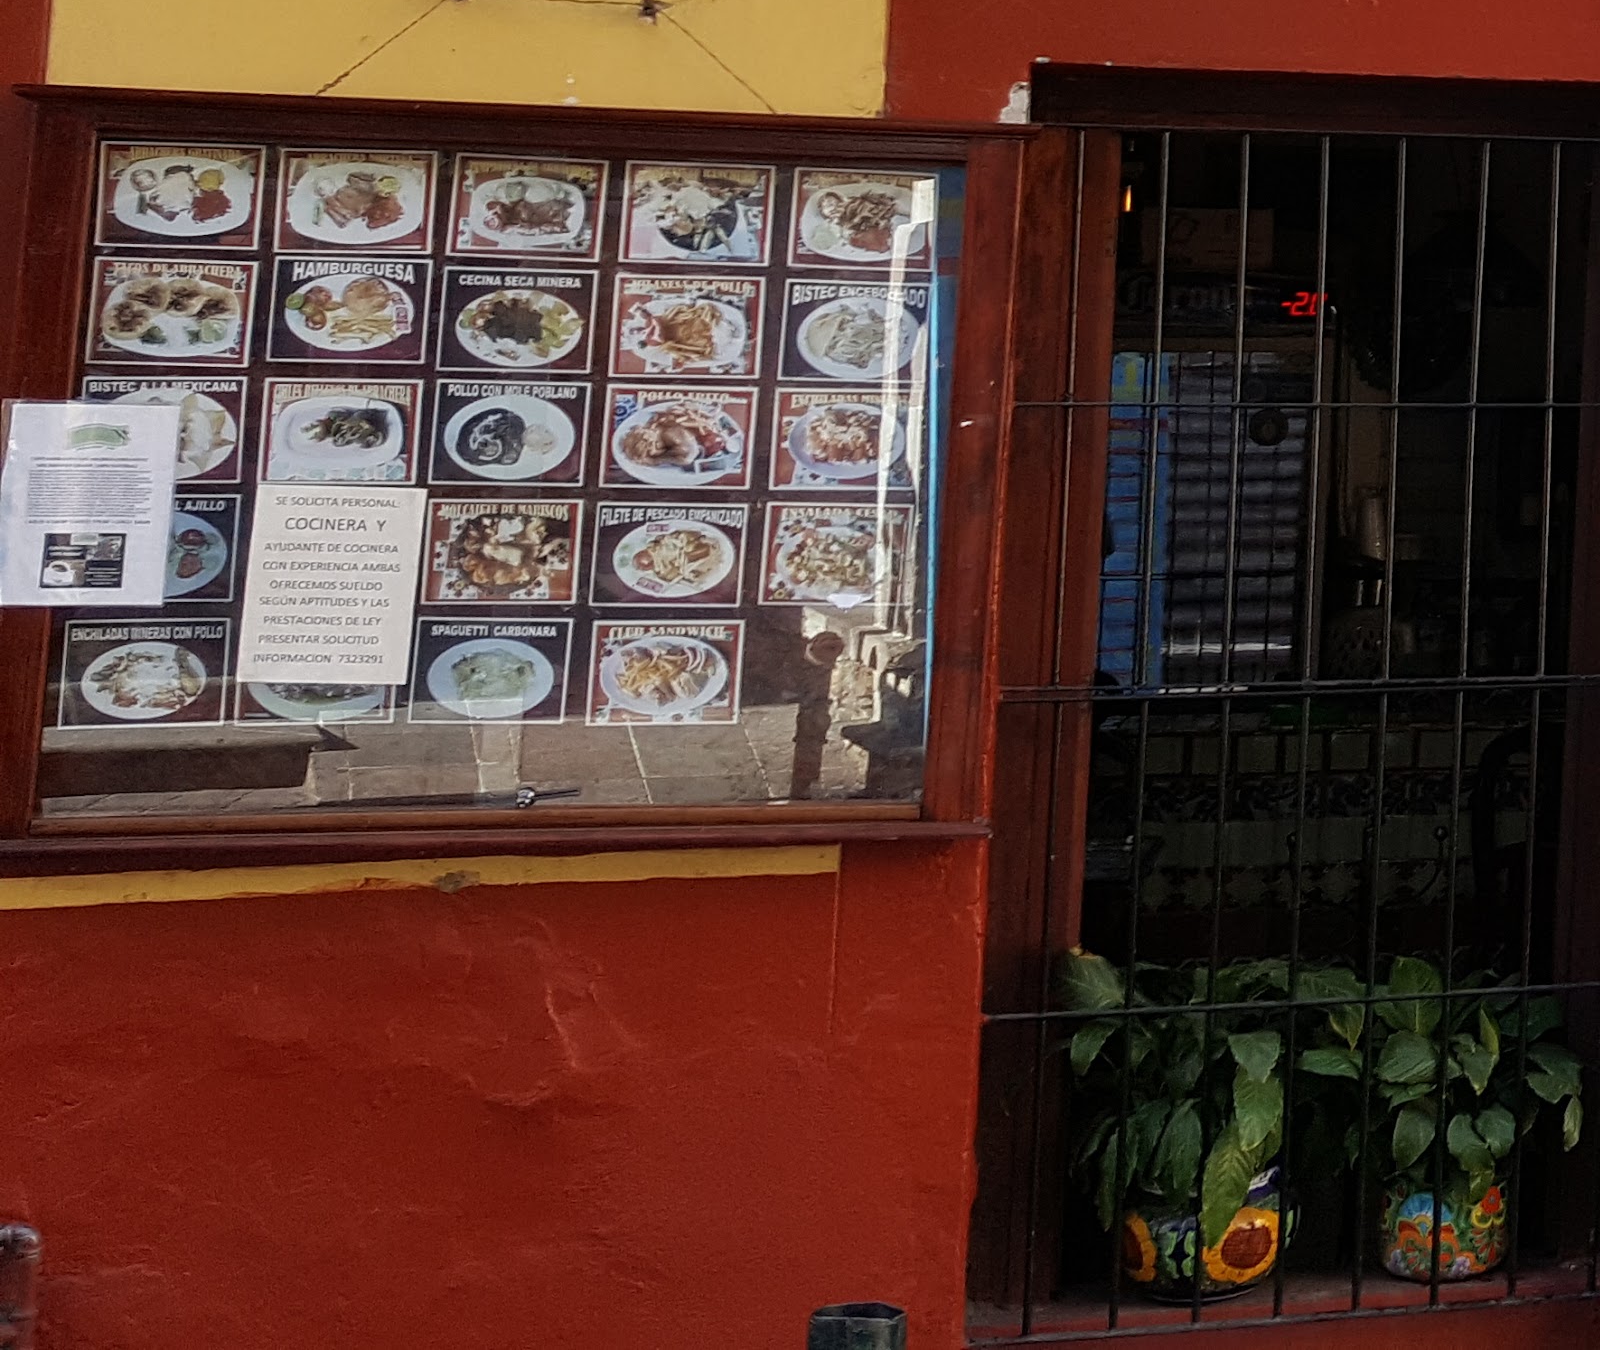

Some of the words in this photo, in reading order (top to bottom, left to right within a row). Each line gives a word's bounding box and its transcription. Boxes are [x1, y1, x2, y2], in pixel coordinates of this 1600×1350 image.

[292, 261, 416, 285] HAMBURGUESA
[459, 274, 502, 286] CECINA
[504, 275, 534, 287] SECA
[536, 276, 582, 289] MINERA
[792, 285, 838, 305] BISTEC
[89, 381, 138, 393] BISTEC
[139, 382, 149, 392] A
[172, 382, 239, 393] MEXICANA
[447, 383, 479, 397] POLLO
[481, 384, 502, 397] CON
[533, 386, 577, 400] POBLANO
[637, 391, 681, 402] POLLO
[183, 500, 226, 511] AJILLO
[276, 497, 289, 506] SE
[291, 497, 338, 507] SOLICITA
[500, 505, 516, 514] DE
[517, 505, 570, 521] MARISCOS
[601, 508, 631, 527] FILETE
[632, 508, 645, 522] DE
[646, 509, 687, 522] PESCADO
[688, 509, 744, 529] EMPANIZADO
[285, 517, 366, 532] COCINERA
[376, 520, 387, 532] Y
[264, 543, 325, 554] AYUDANTE
[327, 544, 342, 553] DE
[344, 544, 399, 554] COCINERA
[262, 561, 287, 571] CON
[290, 562, 358, 572] EXPERIENCIA
[362, 563, 401, 573] AMBAS
[270, 580, 337, 591] OFRECEMOS
[340, 581, 383, 591] SUELDO
[259, 595, 297, 606] SEGÚN
[299, 597, 359, 607] APTITUDES
[361, 597, 367, 607] Y
[370, 598, 390, 608] LAS
[263, 616, 342, 626] PRESTACIONES
[345, 617, 360, 626] DE
[363, 617, 381, 626] LEY
[71, 627, 129, 641] ENCHILADAS
[130, 627, 171, 640] MINERAS
[173, 627, 192, 639] CON
[193, 625, 224, 639] POLLO
[431, 624, 488, 637] SPAGUETTI
[493, 625, 557, 637] CARBONARA
[258, 635, 320, 645] PRESENTAR
[322, 635, 380, 645] SOLICITUD
[253, 654, 333, 664] INFORMACION
[338, 655, 384, 664] 7323291
